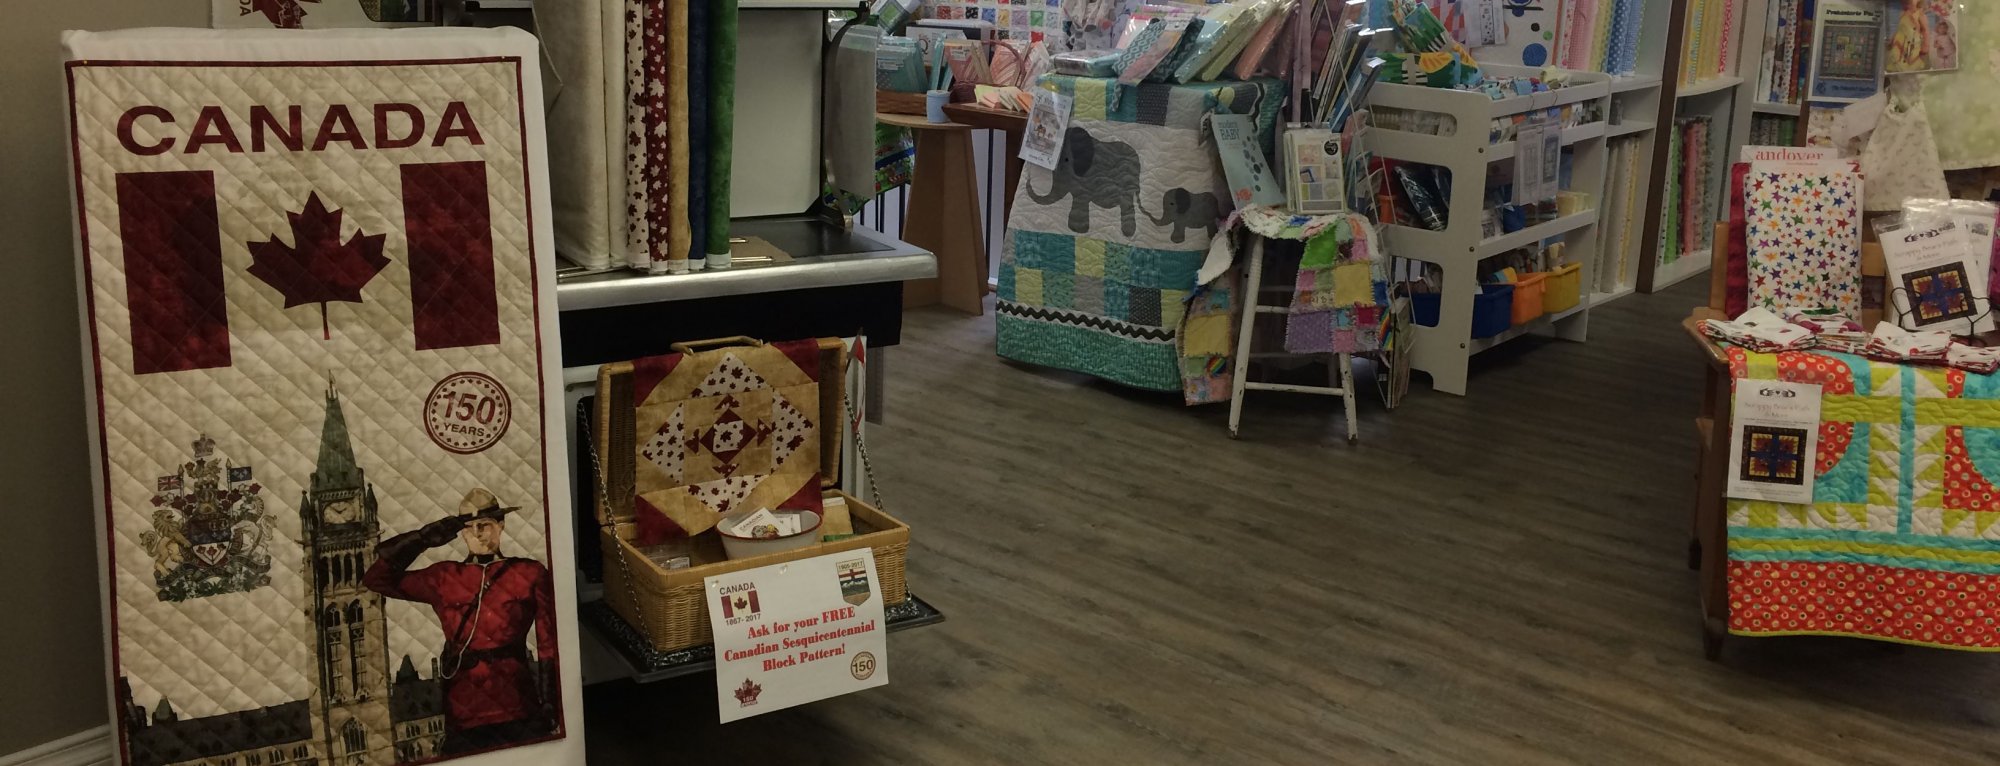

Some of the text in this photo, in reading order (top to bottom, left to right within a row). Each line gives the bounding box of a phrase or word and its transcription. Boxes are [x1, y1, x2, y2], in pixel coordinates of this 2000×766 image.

[116, 101, 485, 156] CANADA
[1219, 128, 1241, 141] BABY
[1755, 148, 1824, 161] andover
[443, 391, 496, 425] 150
[443, 422, 485, 437] YEARS
[719, 582, 756, 595] CANADA
[748, 606, 856, 640] Ask for your FREE
[724, 619, 875, 662] Canadian Sesquicentennial
[763, 642, 846, 672] Block Pattern!
[852, 659, 874, 674] 150
